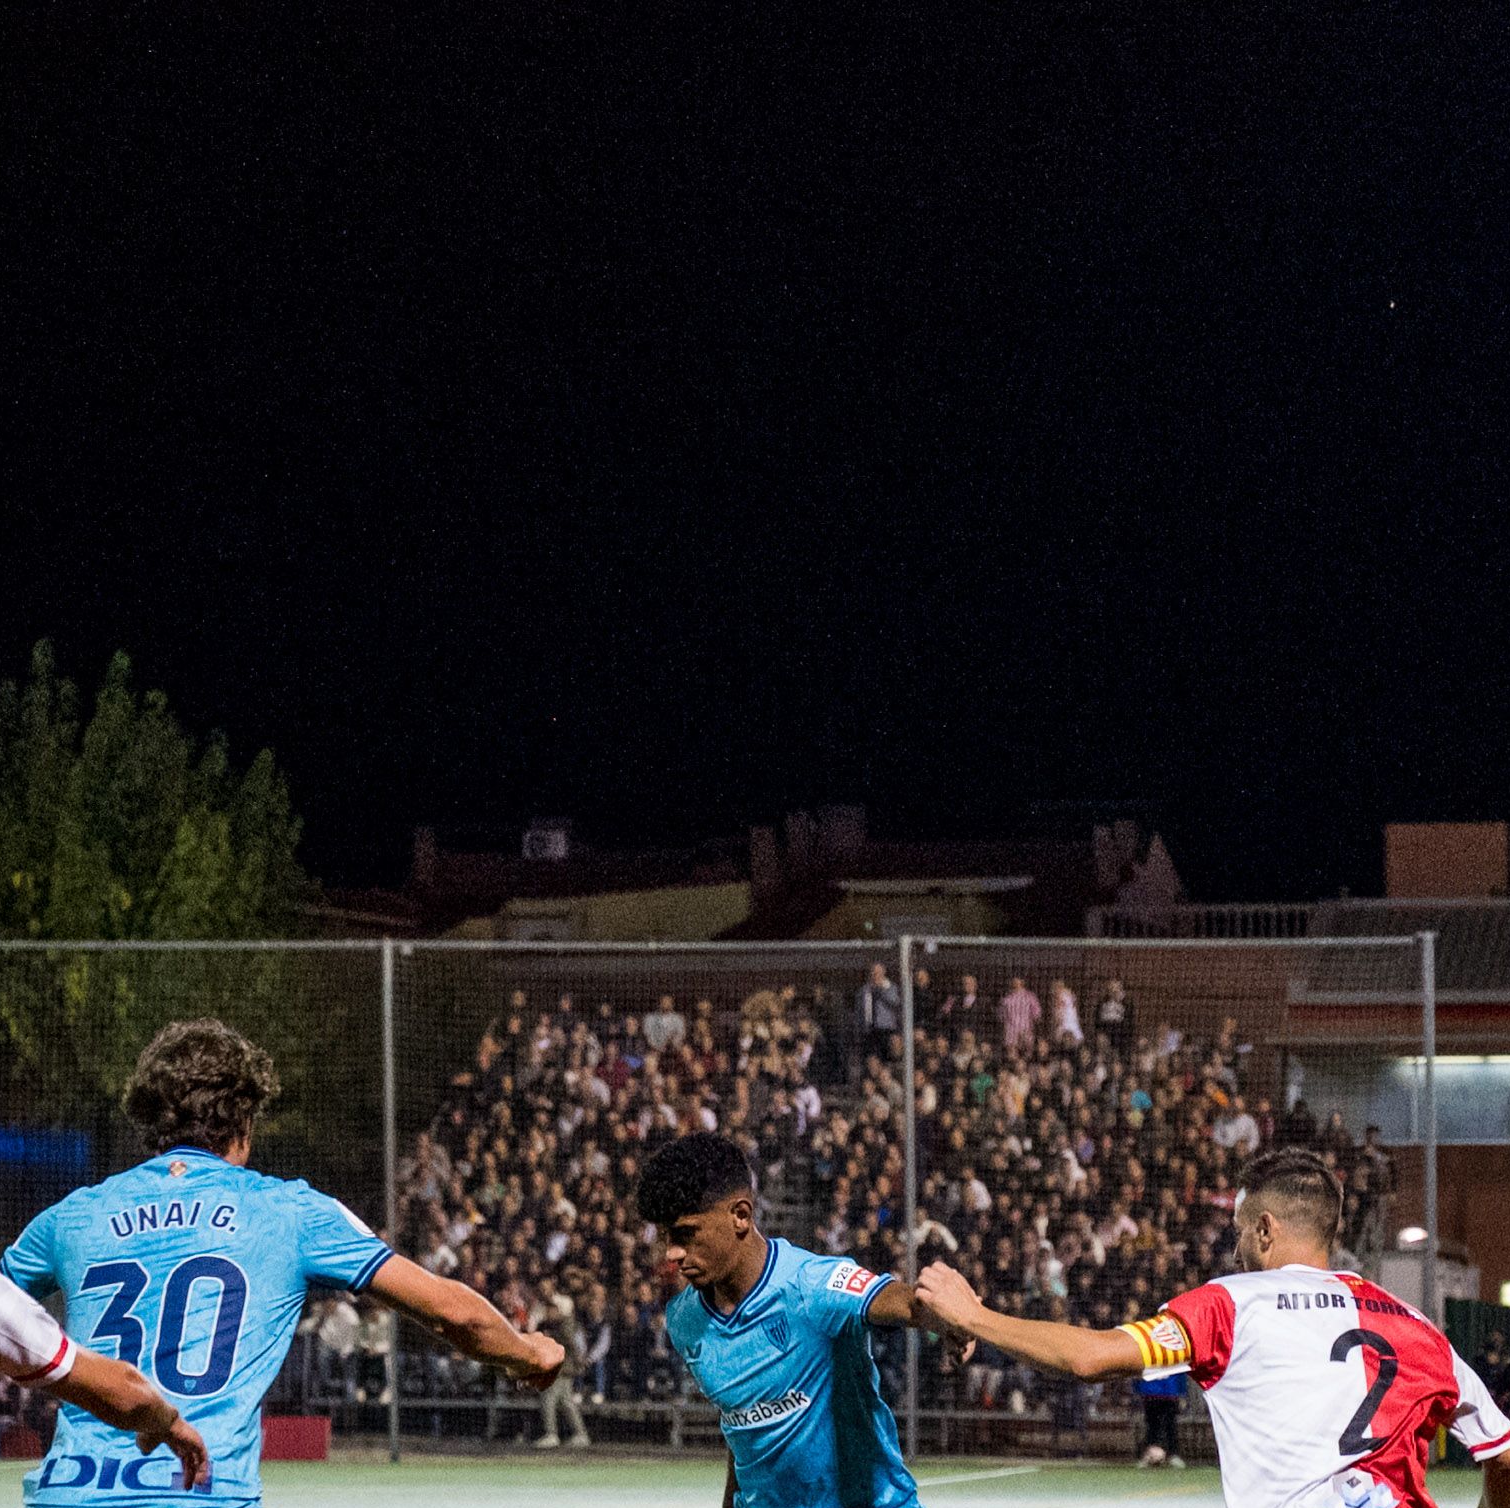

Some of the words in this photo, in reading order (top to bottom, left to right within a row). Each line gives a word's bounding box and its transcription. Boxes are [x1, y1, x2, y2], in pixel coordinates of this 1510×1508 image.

[110, 1200, 202, 1240] UNAI
[210, 1203, 238, 1234] G.
[832, 1265, 854, 1289] B2B
[79, 1253, 250, 1400] 30
[1277, 1292, 1346, 1310] AITOR
[1350, 1296, 1421, 1321] TORR
[1329, 1328, 1398, 1456] 2
